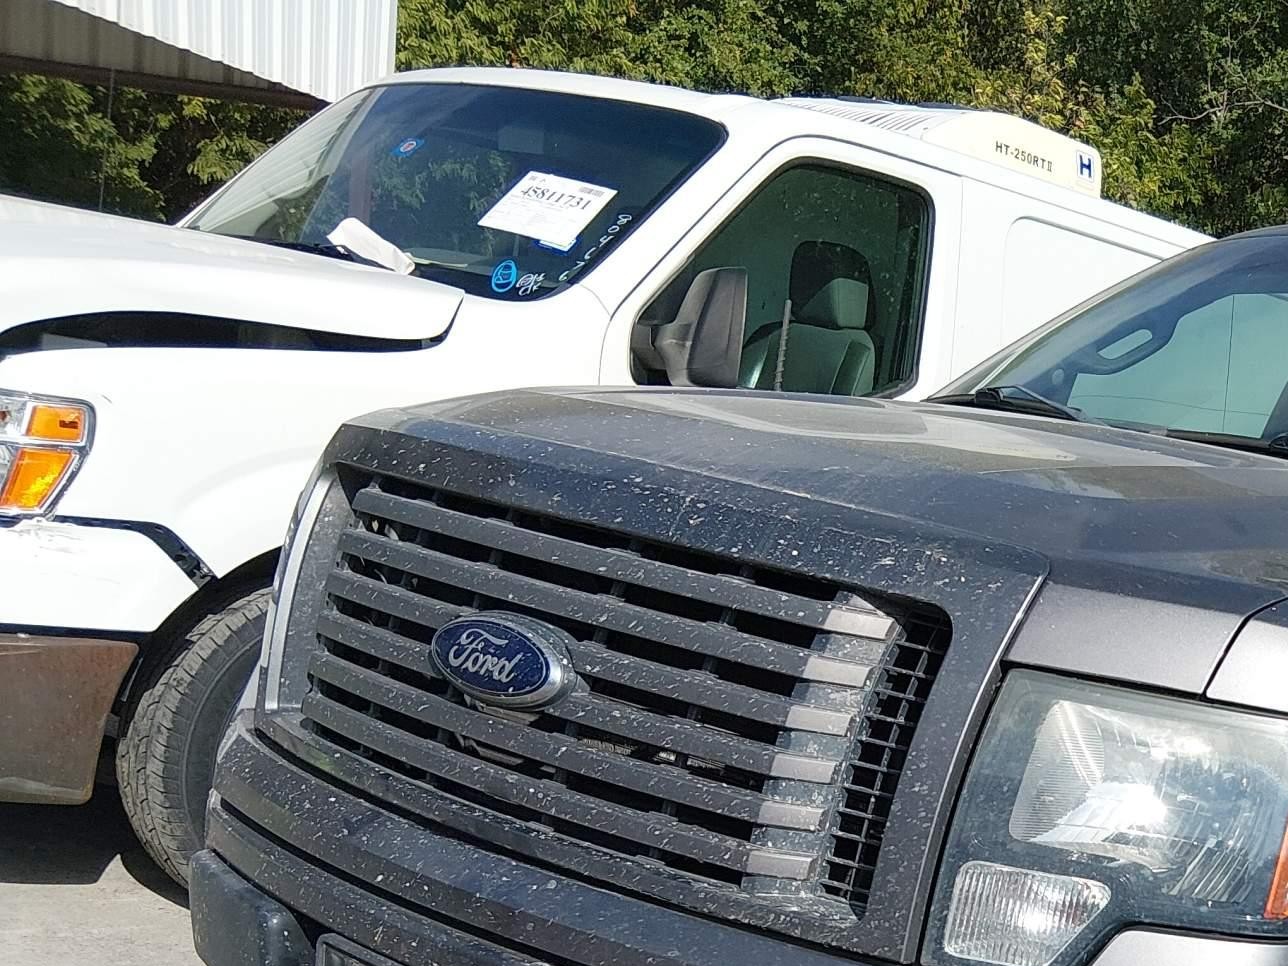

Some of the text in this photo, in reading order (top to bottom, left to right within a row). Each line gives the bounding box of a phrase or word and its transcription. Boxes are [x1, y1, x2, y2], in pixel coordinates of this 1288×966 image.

[1079, 154, 1092, 179] H
[520, 185, 592, 211] 45811731
[448, 628, 524, 683] Ford
